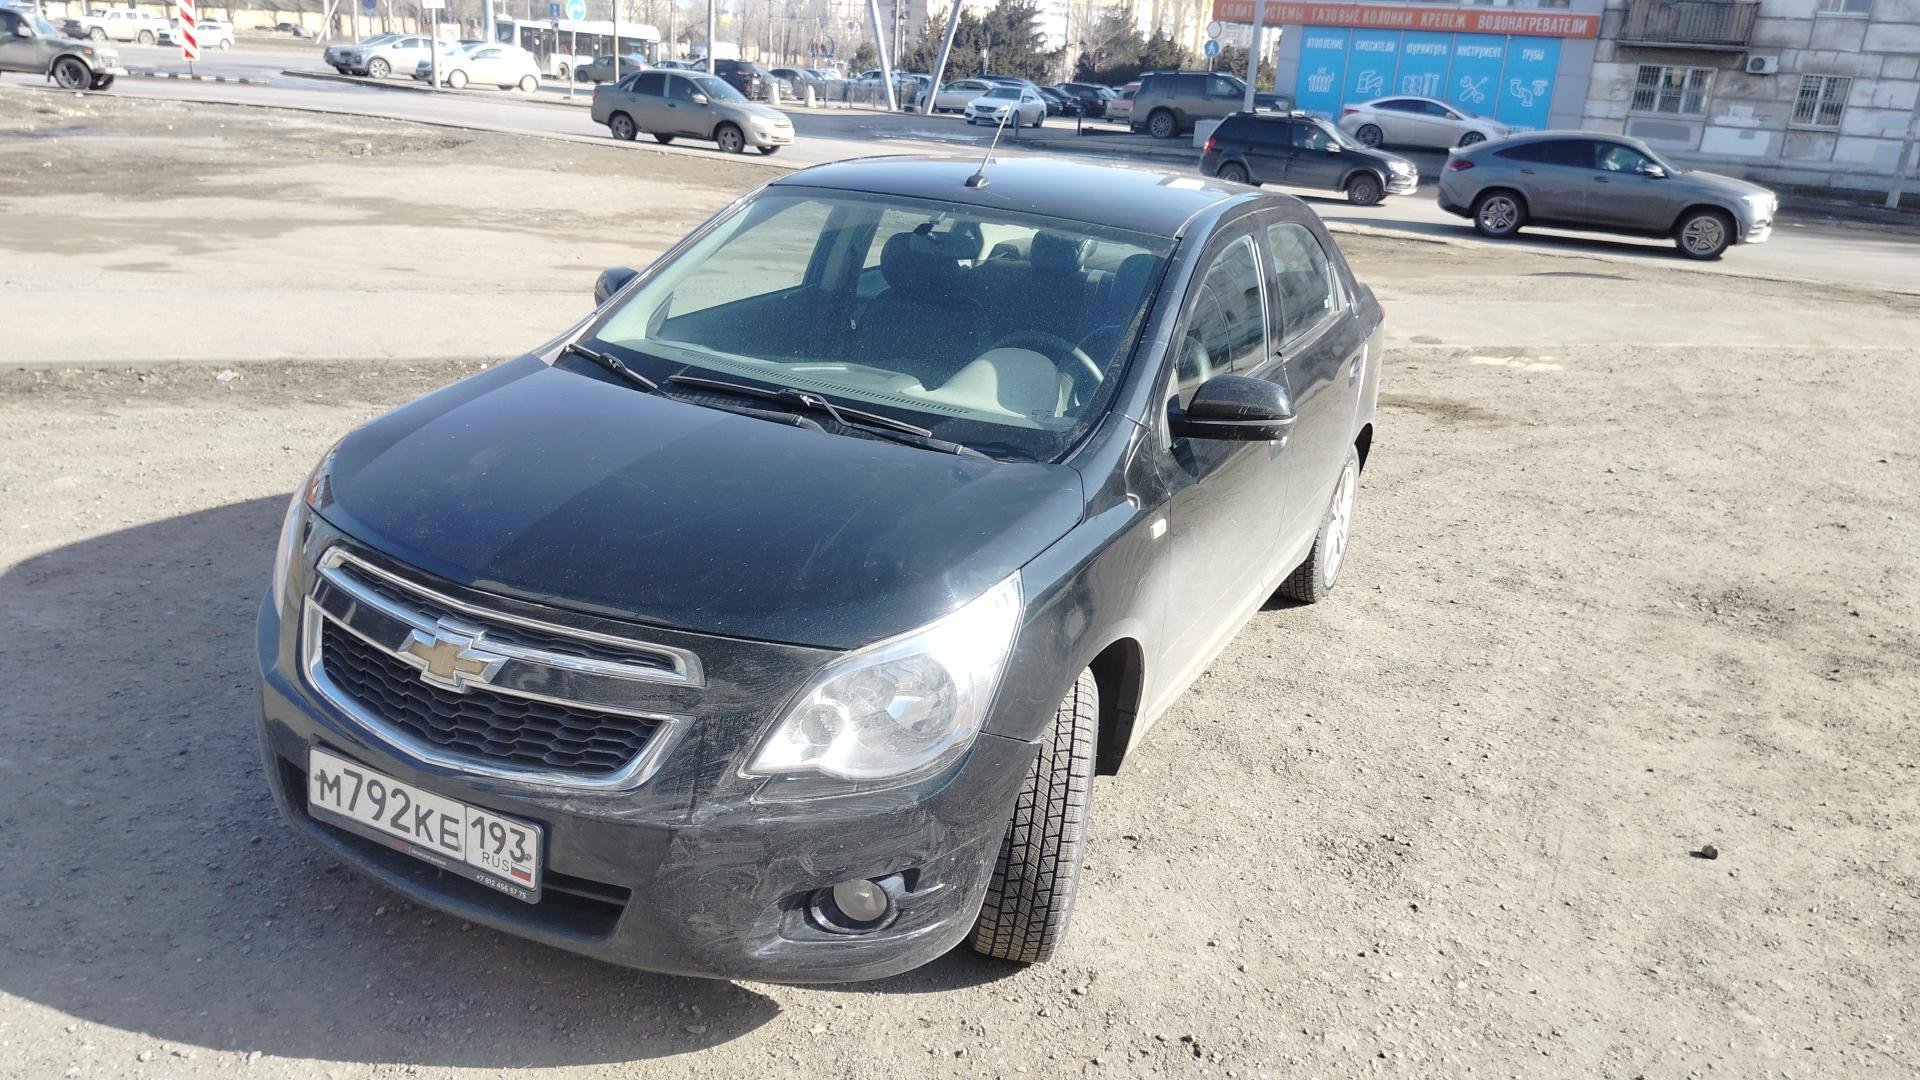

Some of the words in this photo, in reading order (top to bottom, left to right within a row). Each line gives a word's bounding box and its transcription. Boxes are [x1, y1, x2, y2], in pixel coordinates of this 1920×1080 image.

[1220, 4, 1253, 18] СПЛИТ
[1262, 6, 1305, 20] ИСТЕМЫ
[1311, 8, 1360, 23] ГАЗОВЫЕ
[1362, 10, 1413, 25] КОЛОНКИ
[1420, 12, 1466, 28] КРЕПЕЖ
[1477, 14, 1588, 33] ВОДОНАГРЕВАТЕЛИ
[1306, 37, 1344, 50] ОТОПЛЕНИЕ
[1355, 39, 1395, 53] СМЕСИТЕЛИ
[1406, 43, 1447, 56] ФУРНИТУРА
[1456, 45, 1502, 59] ИНСТРУМЕНТ
[1522, 48, 1544, 61] ТРУБЫ
[319, 768, 460, 852] М792КЕ
[471, 816, 526, 863] 193
[482, 851, 511, 872] RUS
